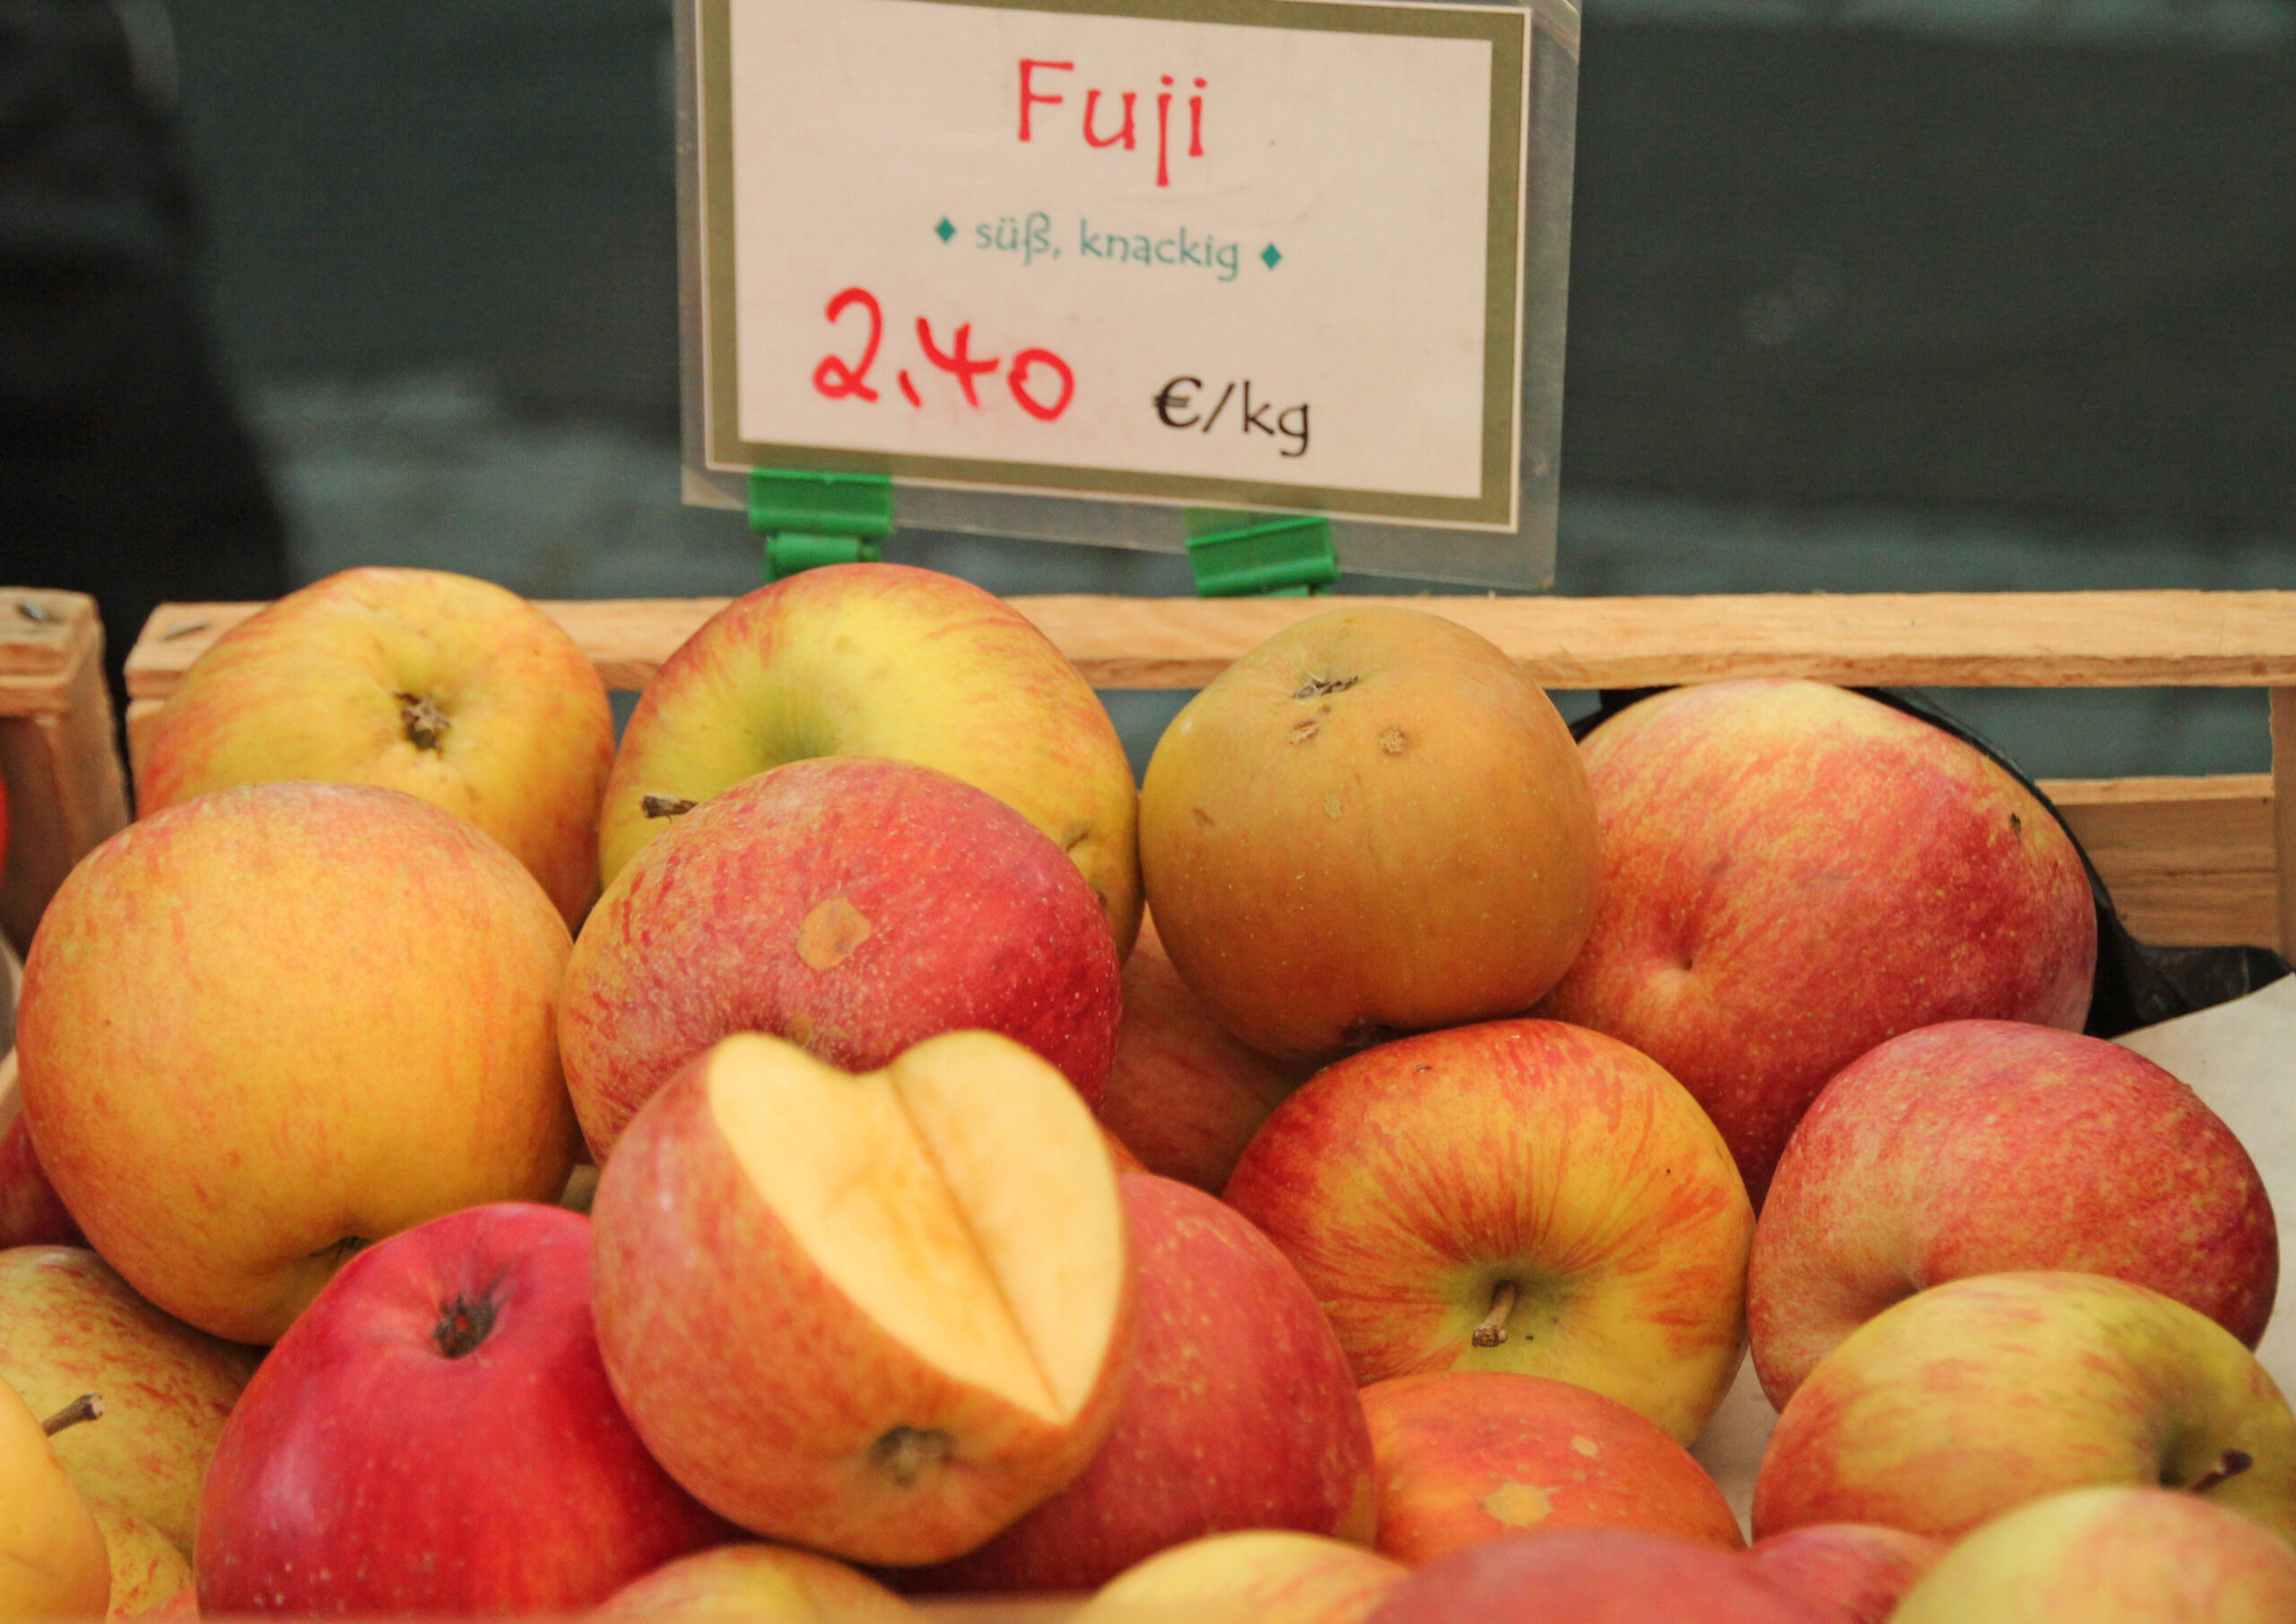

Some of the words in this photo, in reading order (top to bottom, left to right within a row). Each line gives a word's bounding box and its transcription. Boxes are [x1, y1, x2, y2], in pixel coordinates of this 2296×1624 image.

[1018, 57, 1208, 187] Fuji
[976, 213, 1062, 266] süß,
[1079, 218, 1239, 281] knackig
[1152, 375, 1312, 458] €/kg
